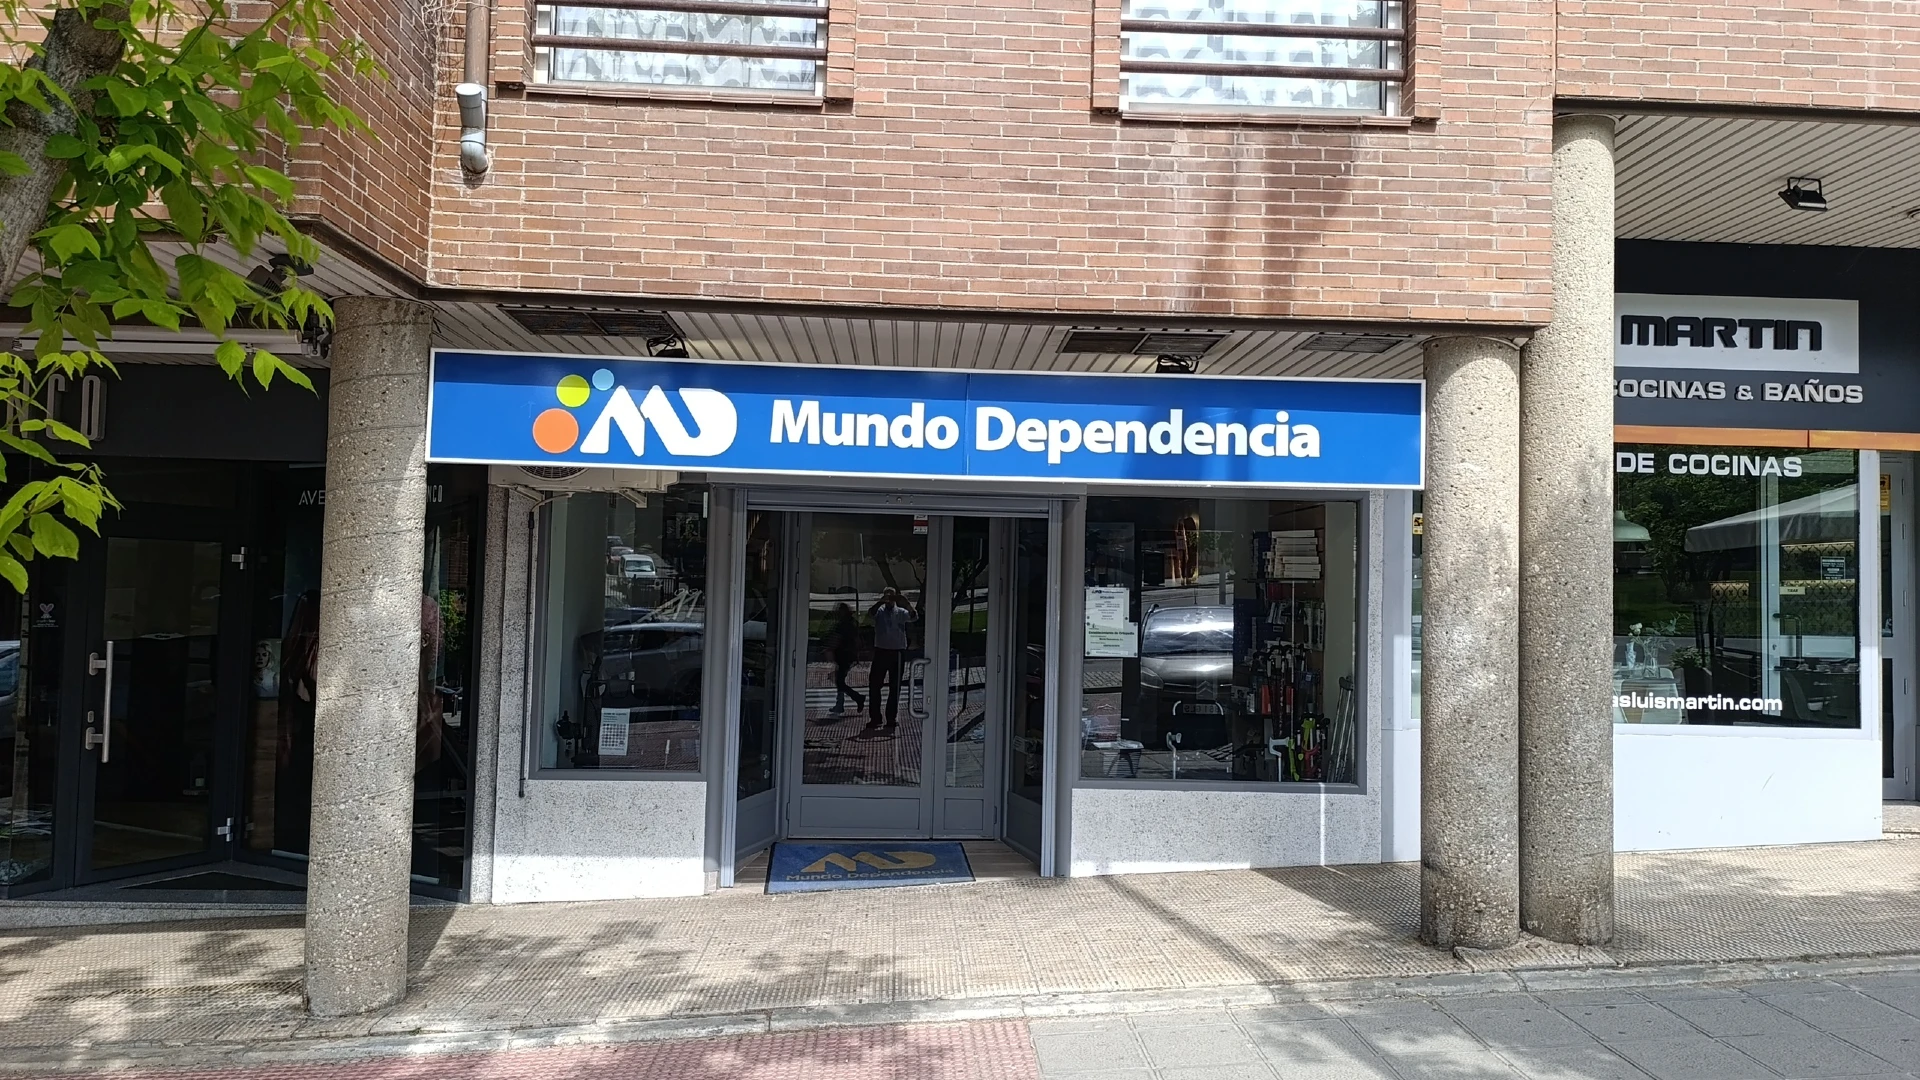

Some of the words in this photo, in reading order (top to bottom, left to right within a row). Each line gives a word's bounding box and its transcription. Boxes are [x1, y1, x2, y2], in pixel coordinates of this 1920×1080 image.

[1620, 314, 1823, 351] MARTIN
[1613, 379, 1726, 400] OCINAS
[1737, 385, 1754, 401] &
[1765, 378, 1863, 404] BAÑOS
[770, 399, 960, 450] Mundo
[975, 406, 1321, 465] Dependencia
[1616, 451, 1655, 474] DE
[1668, 453, 1803, 478] COCINAS
[786, 873, 842, 881] Mundo
[847, 868, 955, 879] Dependencia
